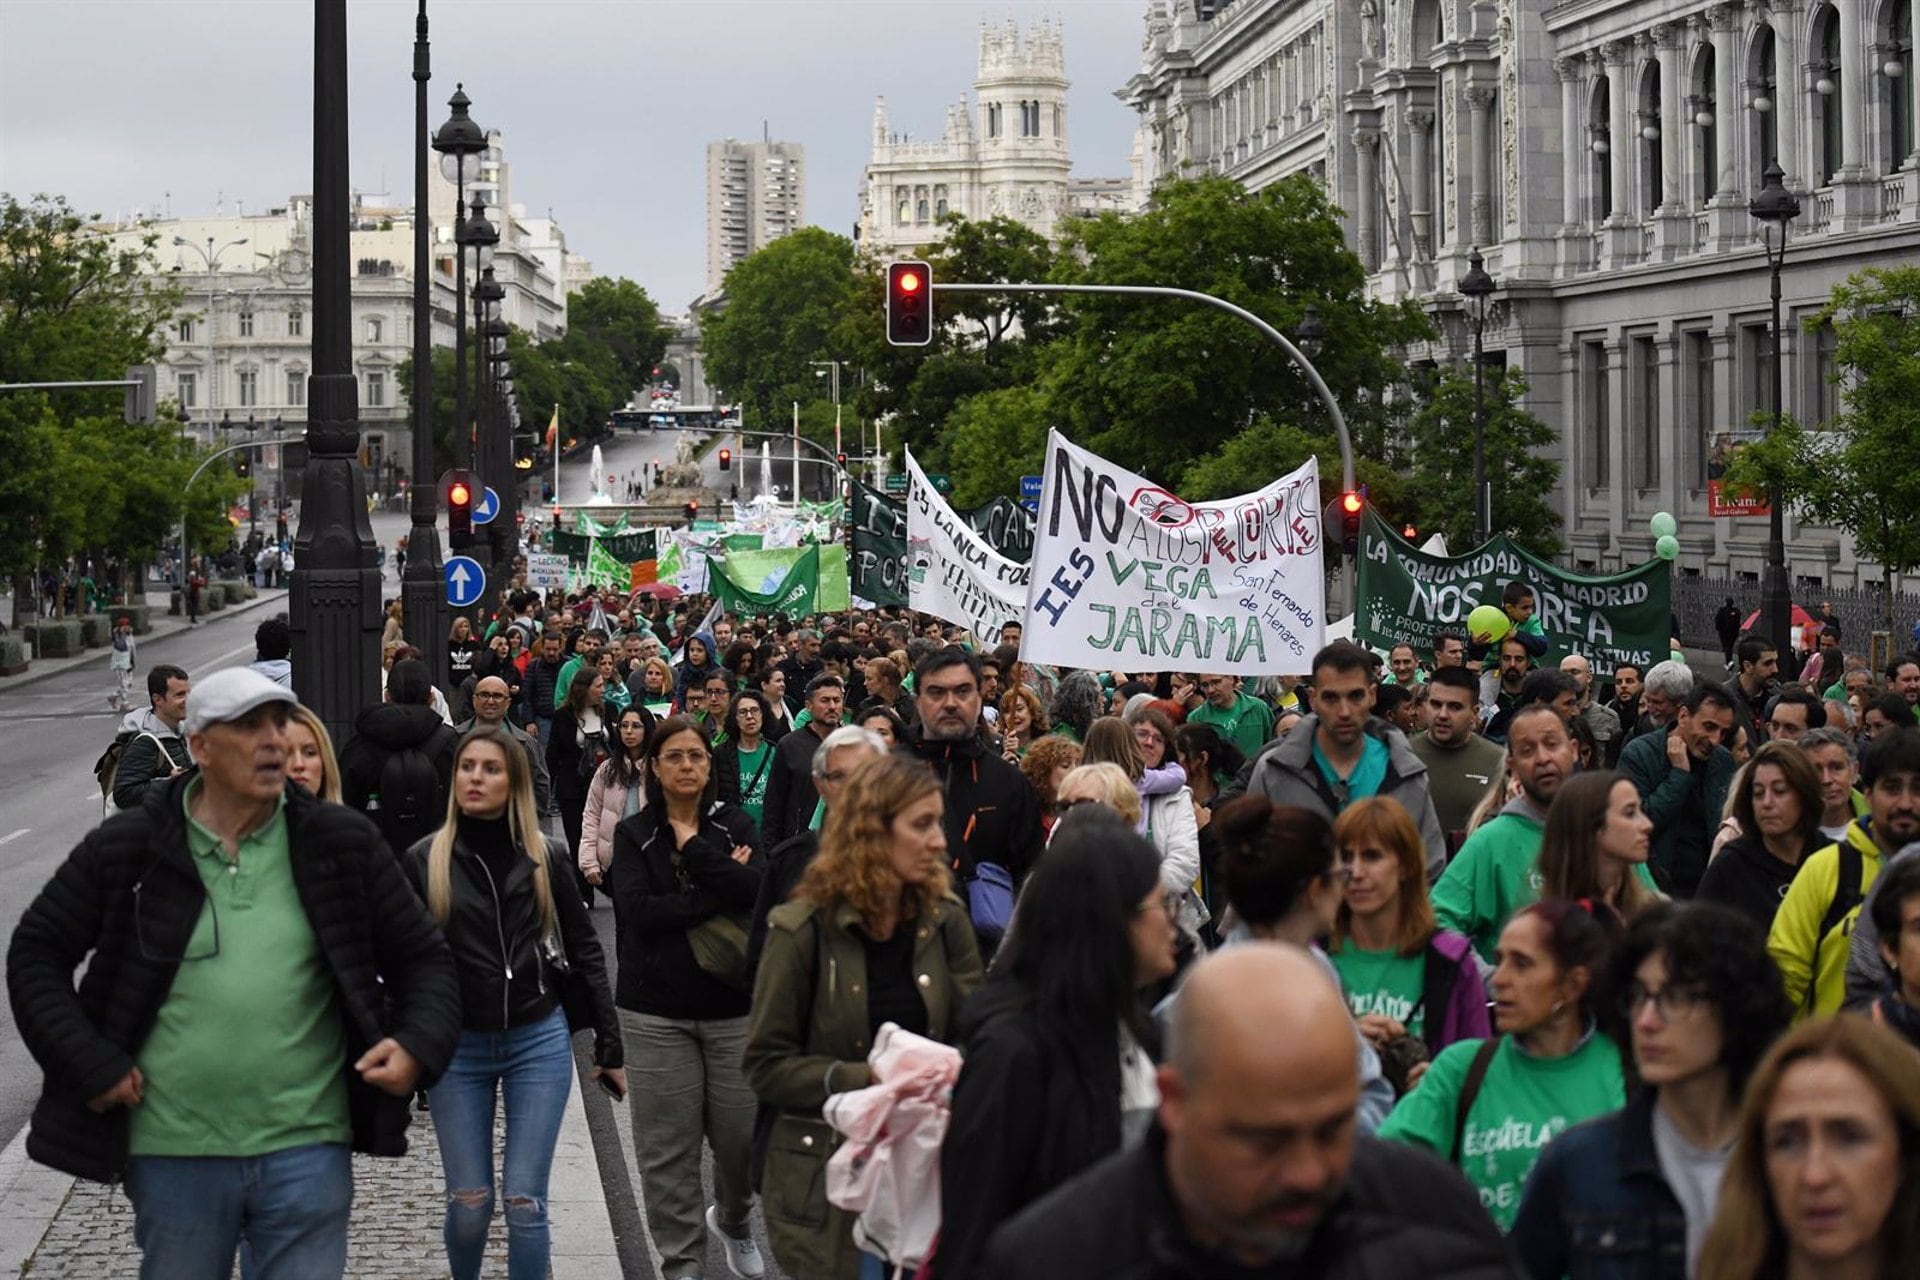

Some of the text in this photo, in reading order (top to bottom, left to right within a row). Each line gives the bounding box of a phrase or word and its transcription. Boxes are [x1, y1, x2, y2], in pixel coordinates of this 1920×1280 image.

[1048, 447, 1126, 544] NO
[1127, 516, 1150, 558] A
[1156, 526, 1202, 566] LOS
[1105, 549, 1218, 600] VEGA
[1231, 565, 1314, 629] San Fernando
[1366, 534, 1649, 607] LA COMUNIDAD DE MADRID
[1140, 592, 1182, 610] del
[1239, 593, 1306, 657] de Henares
[1395, 615, 1467, 637] PROFESORA
[1407, 578, 1483, 625] NOS
[1086, 603, 1267, 663] JARAMA
[1588, 661, 1614, 677] ALI
